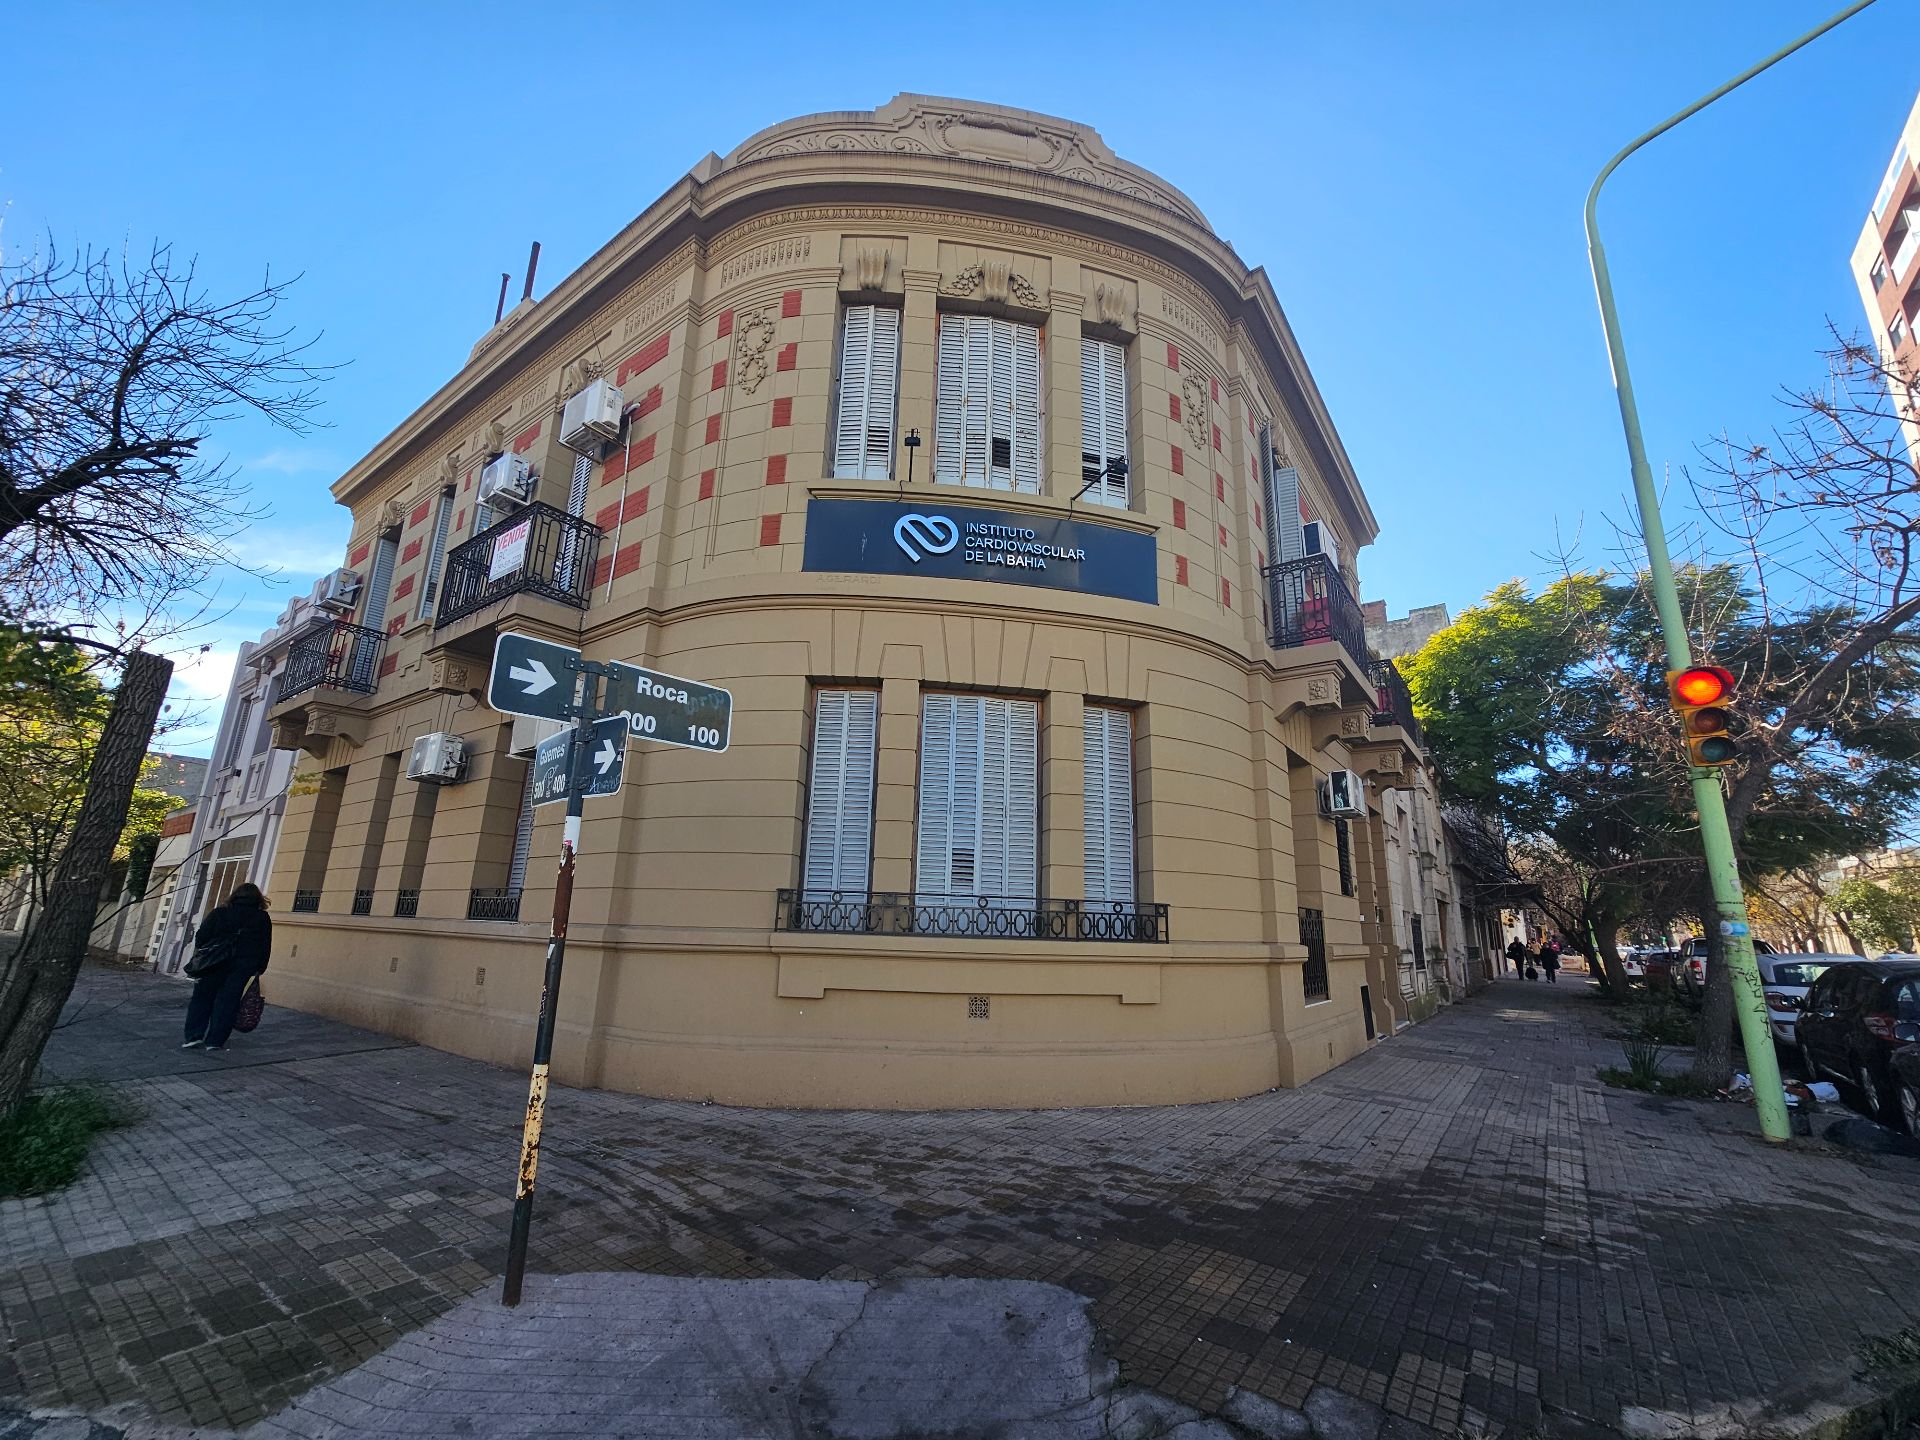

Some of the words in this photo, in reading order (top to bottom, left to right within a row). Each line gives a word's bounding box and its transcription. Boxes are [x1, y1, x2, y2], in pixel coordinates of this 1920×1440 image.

[496, 522, 528, 551] VENDE
[966, 522, 1035, 540] INSTITUTO
[965, 537, 1086, 561] CARDIOVASCULAR
[965, 550, 984, 562] DE
[987, 553, 1004, 564] LA
[1006, 554, 1047, 569] BAHIA
[636, 675, 688, 705] Roca
[688, 724, 720, 746] 100
[552, 773, 566, 794] 400
